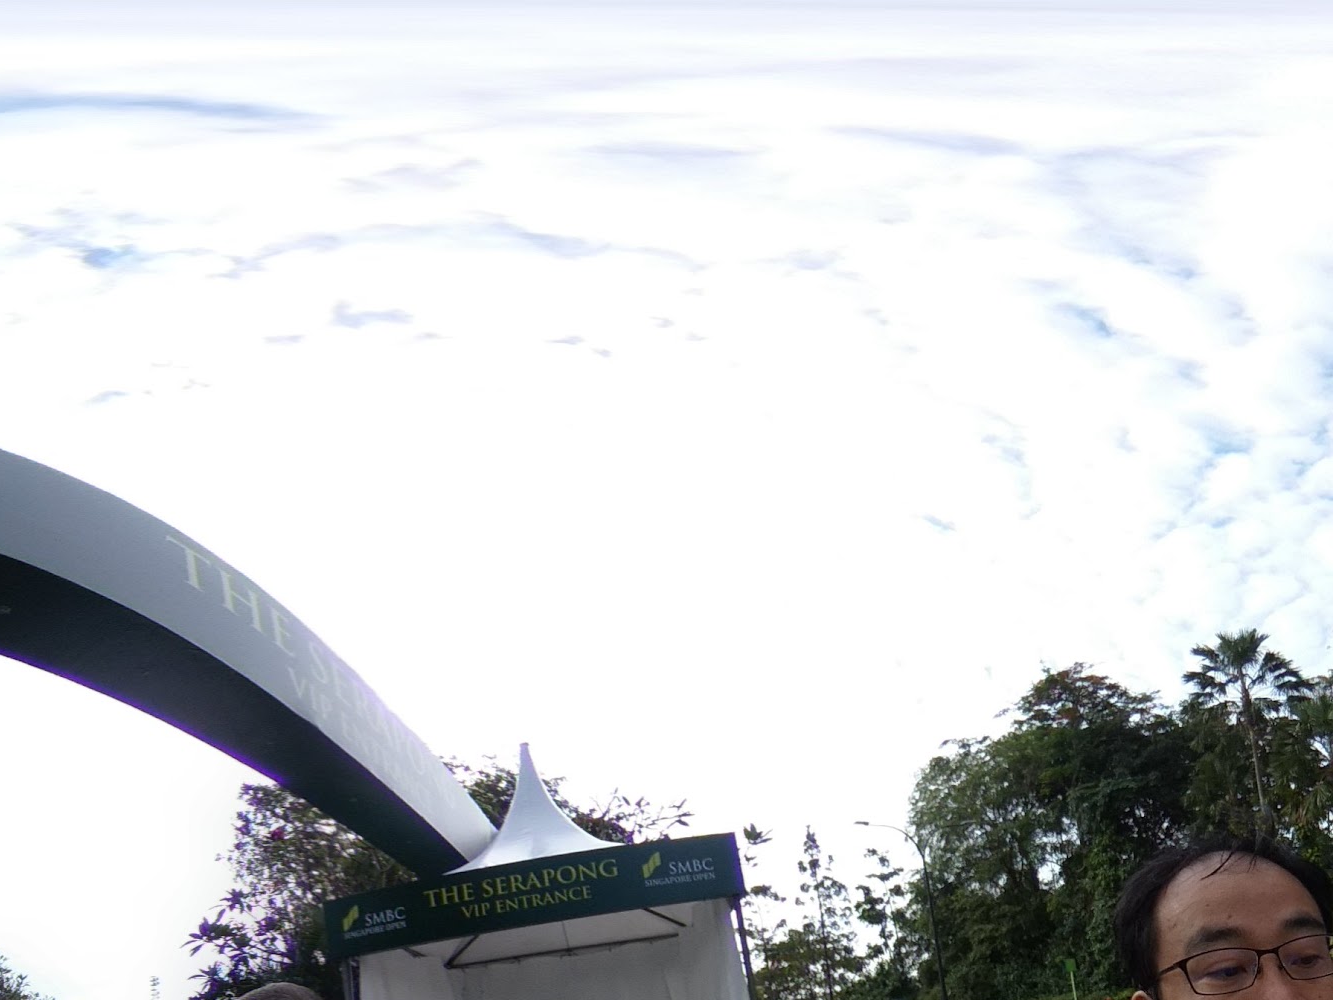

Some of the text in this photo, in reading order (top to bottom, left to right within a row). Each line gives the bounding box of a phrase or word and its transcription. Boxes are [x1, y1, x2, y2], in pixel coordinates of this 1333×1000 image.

[165, 534, 296, 657] THE
[644, 872, 715, 887] SINGAPORE OPEN
[668, 857, 715, 875] SMBC
[423, 859, 619, 908] THE SERAPONG
[461, 885, 592, 919] VIP ENTRANCE
[364, 906, 406, 927] SMBC
